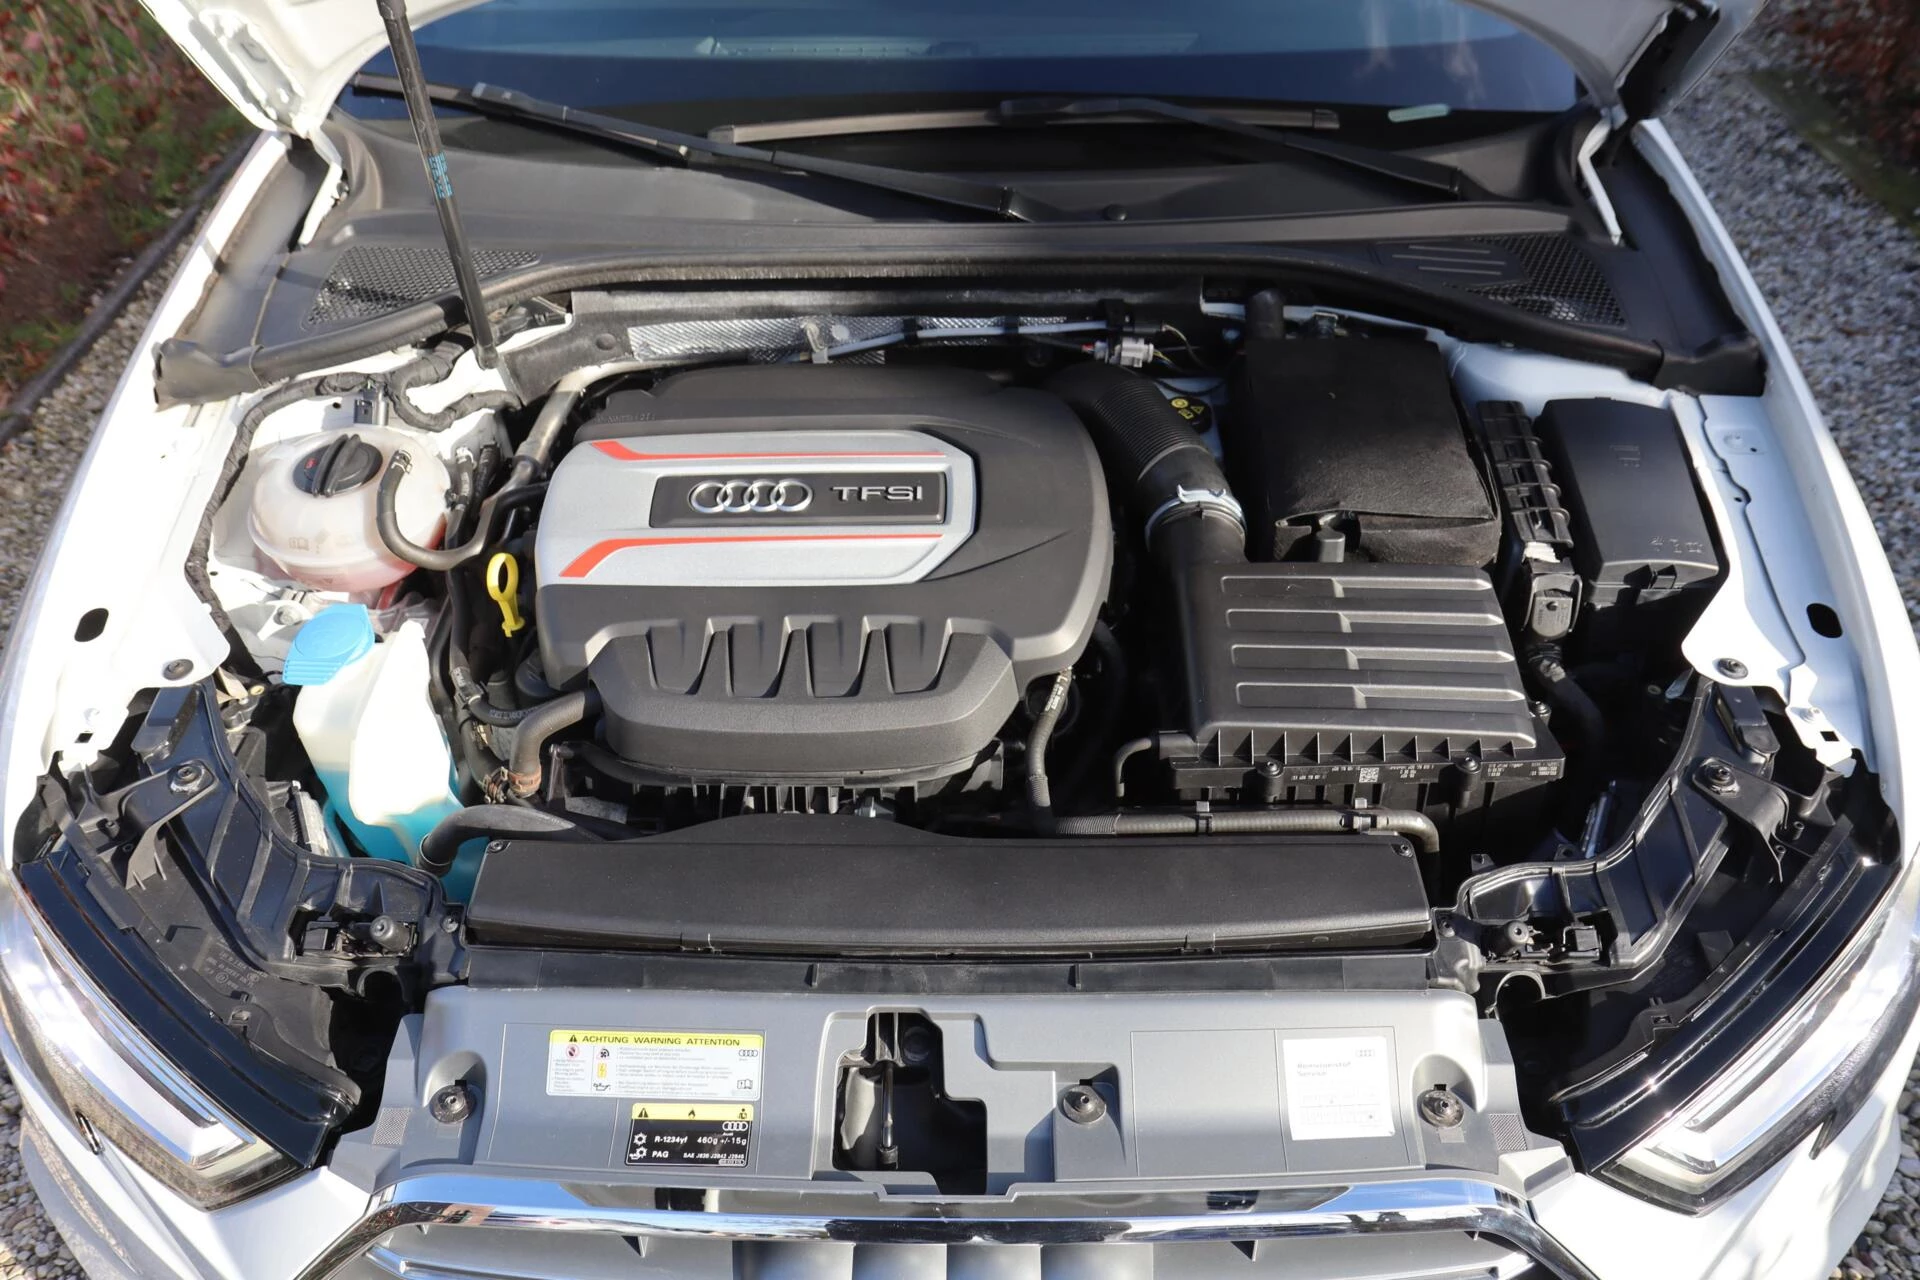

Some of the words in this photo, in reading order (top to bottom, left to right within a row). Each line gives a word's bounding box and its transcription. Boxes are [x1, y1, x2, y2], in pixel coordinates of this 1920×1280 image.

[829, 486, 923, 501] TFSI
[582, 1035, 629, 1044] ACHTUNG
[633, 1036, 682, 1045] WARNING
[686, 1038, 740, 1046] ATTENTION
[654, 1135, 688, 1144] R-1234yf
[697, 1136, 718, 1146] 460g
[651, 1150, 669, 1158] PAG
